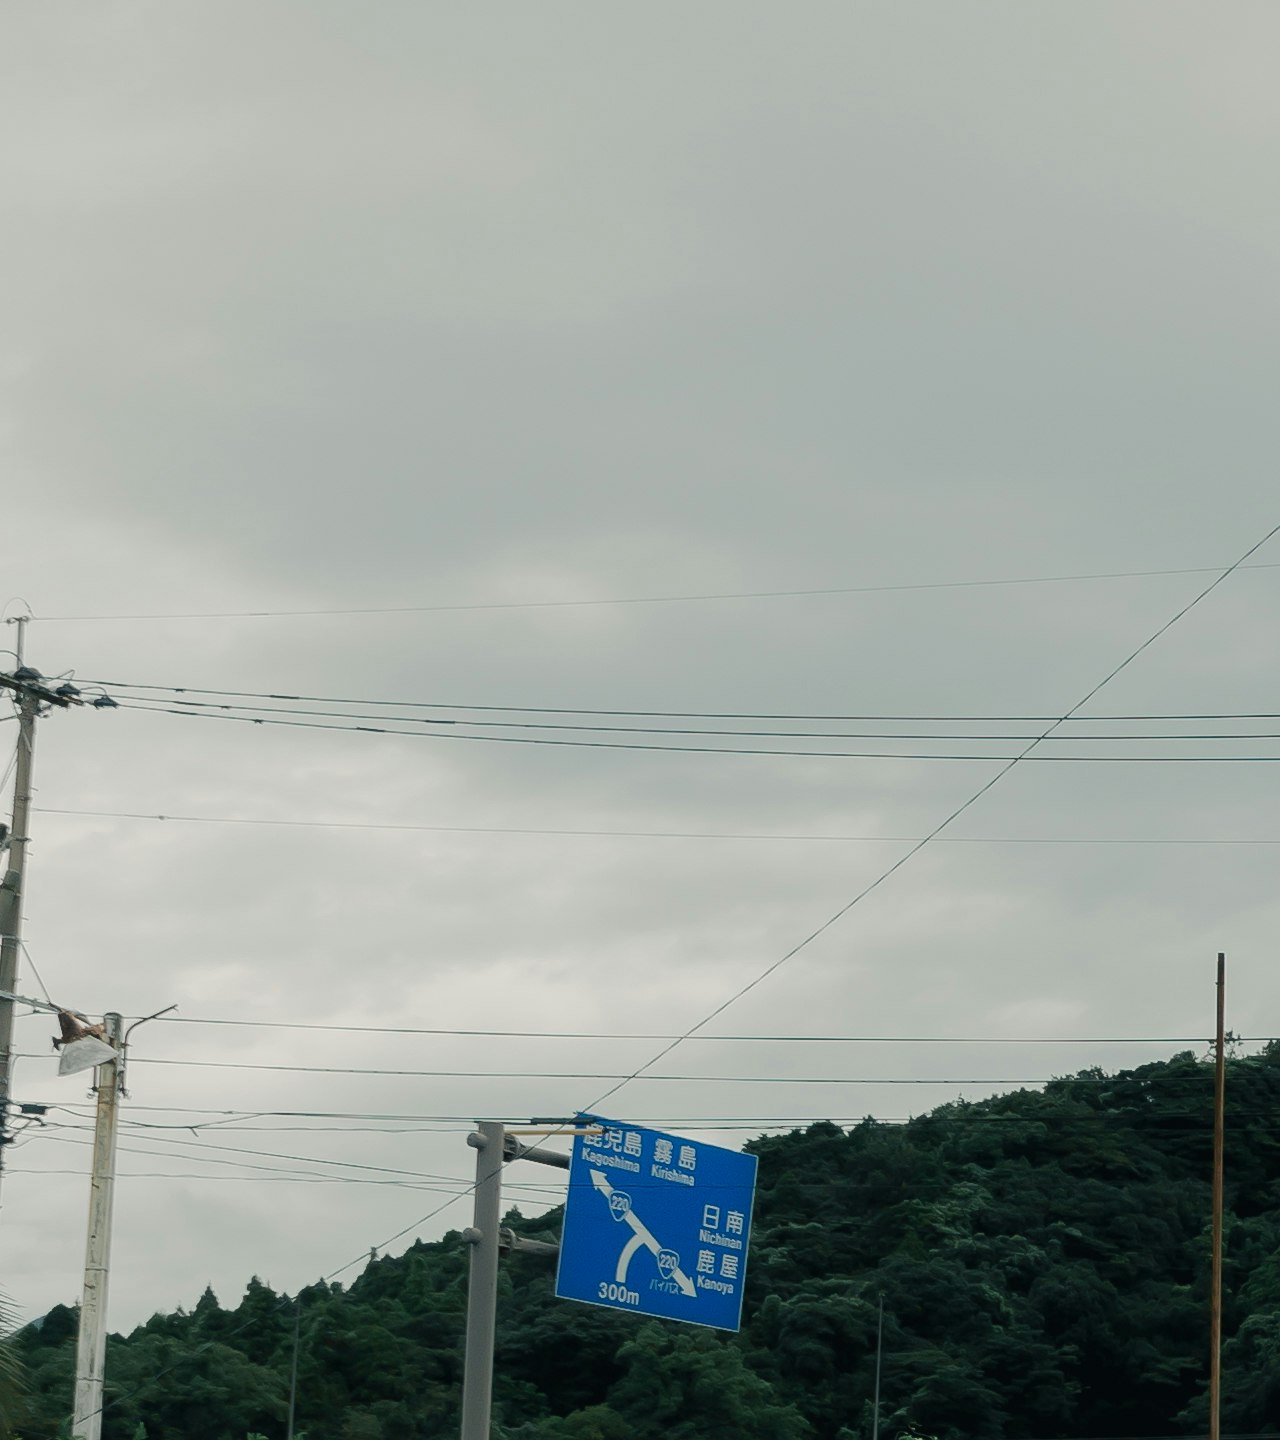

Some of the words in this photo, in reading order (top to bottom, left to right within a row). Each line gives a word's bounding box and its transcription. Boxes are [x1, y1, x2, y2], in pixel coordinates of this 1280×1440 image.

[581, 1147, 640, 1173] Kagoshima
[653, 1138, 696, 1171] 霧島
[651, 1163, 695, 1187] Kirishima
[611, 1195, 629, 1212] 220
[702, 1204, 745, 1235] 日南
[699, 1229, 742, 1250] Nichinan
[658, 1253, 677, 1270] 220
[696, 1249, 739, 1279] 鹿屋
[598, 1281, 639, 1306] 300m
[649, 1278, 680, 1295] バイパス
[697, 1274, 734, 1295] Kanoya
